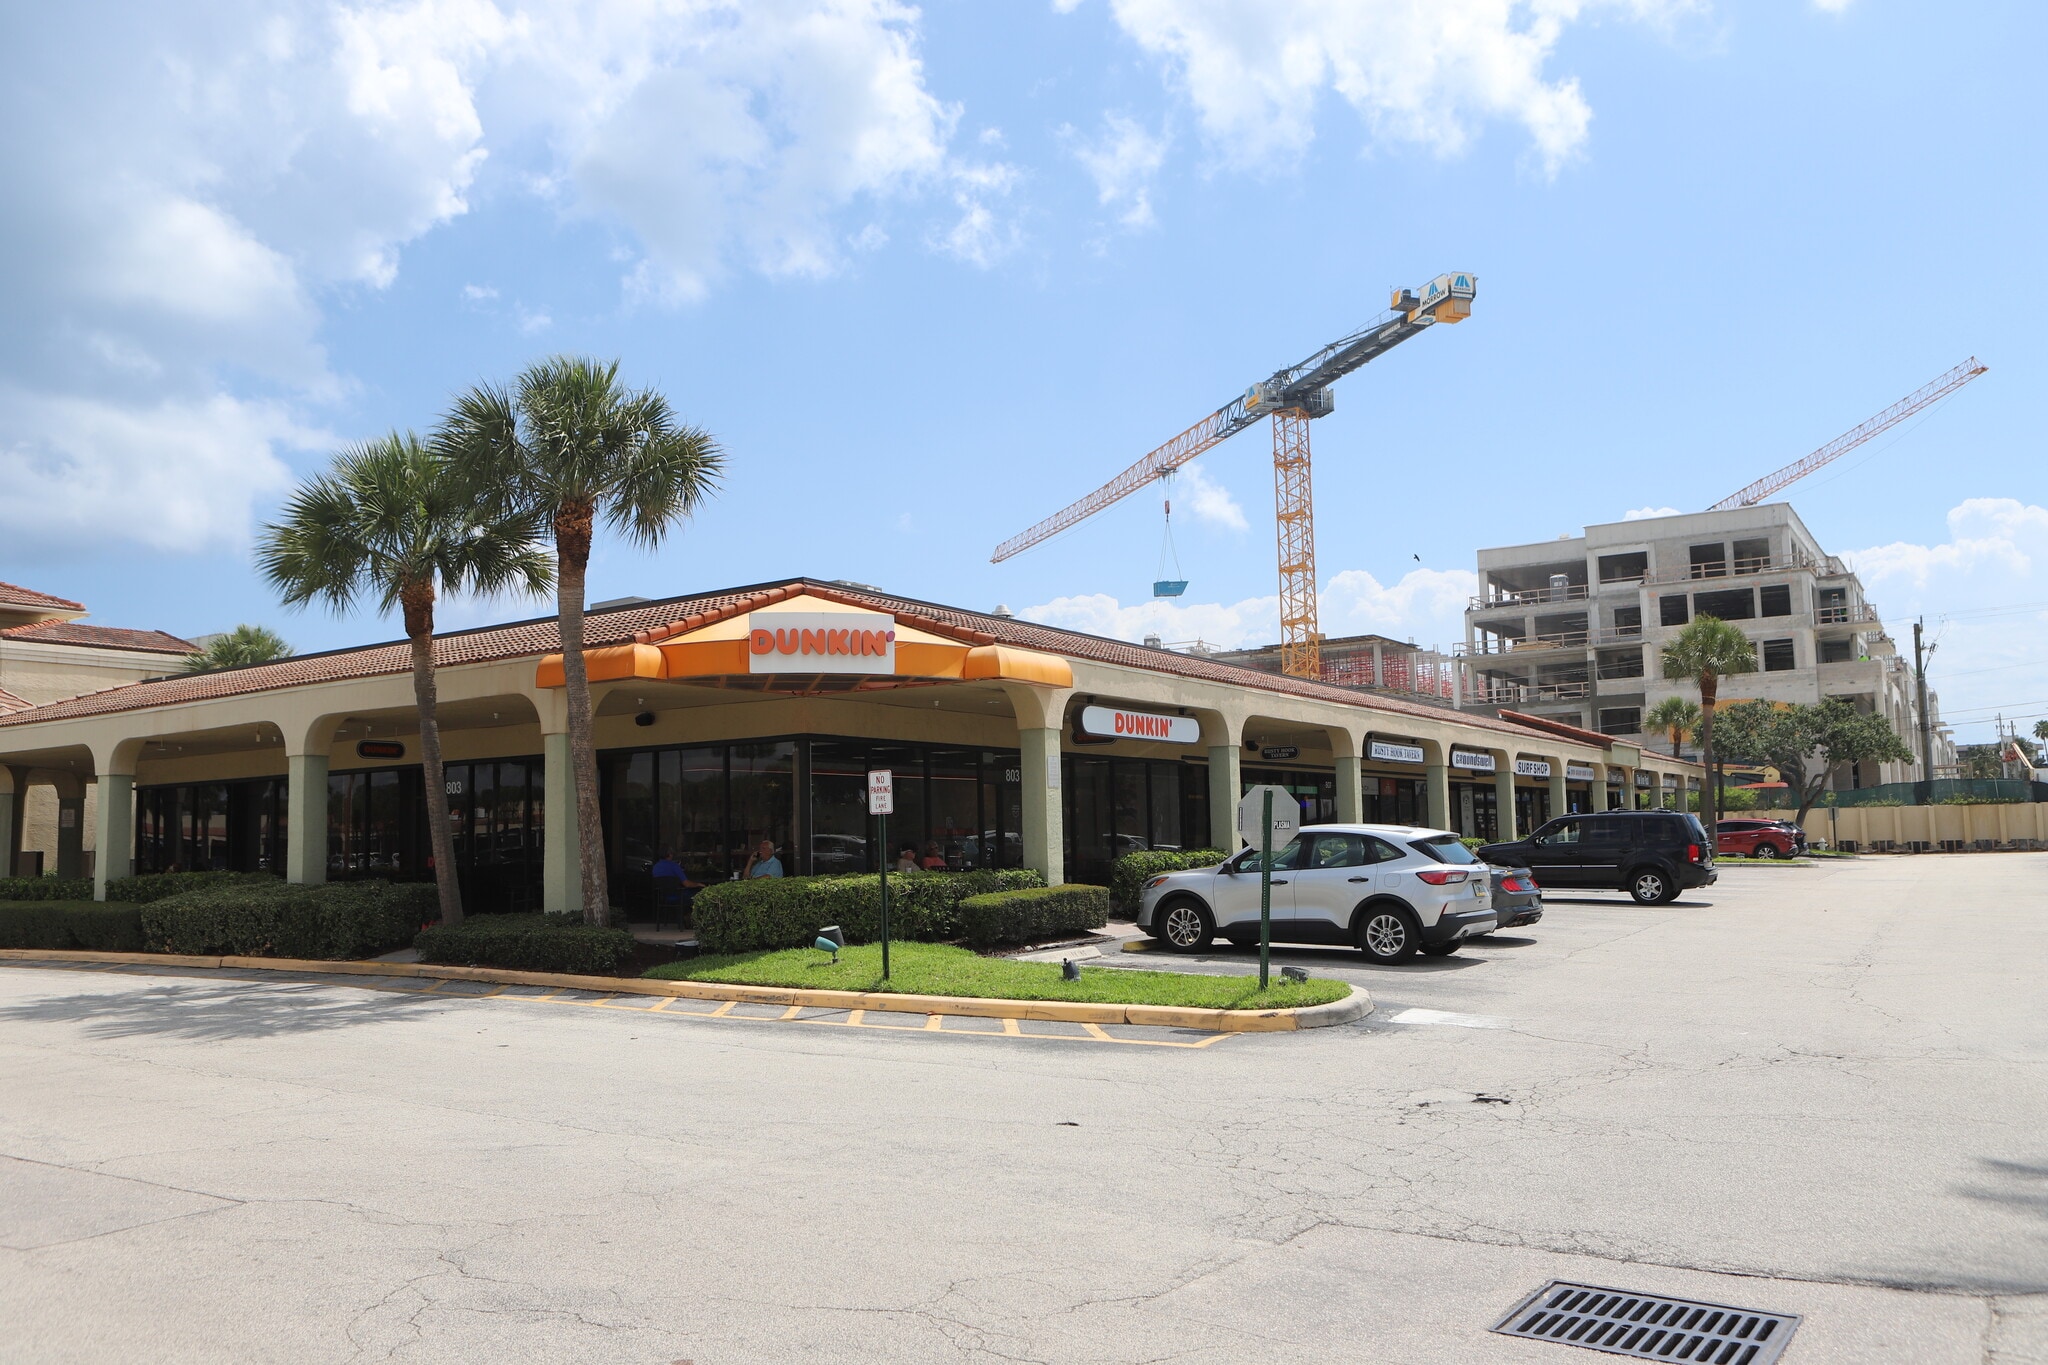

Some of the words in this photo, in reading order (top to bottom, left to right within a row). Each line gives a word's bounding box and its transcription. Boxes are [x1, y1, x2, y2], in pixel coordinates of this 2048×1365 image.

[1421, 288, 1446, 307] MORROW
[750, 628, 896, 657] DUNKIN'
[1114, 712, 1173, 738] DUNKIN'
[1374, 745, 1389, 756] RUSTY
[1390, 746, 1404, 758] HOOK
[1404, 747, 1421, 760] TAVERN
[1517, 761, 1533, 774] SURF
[1533, 763, 1549, 775] SHOP
[875, 775, 885, 784] NO
[1005, 769, 1020, 782] 803
[445, 781, 462, 795] 803
[870, 784, 891, 794] PARKING
